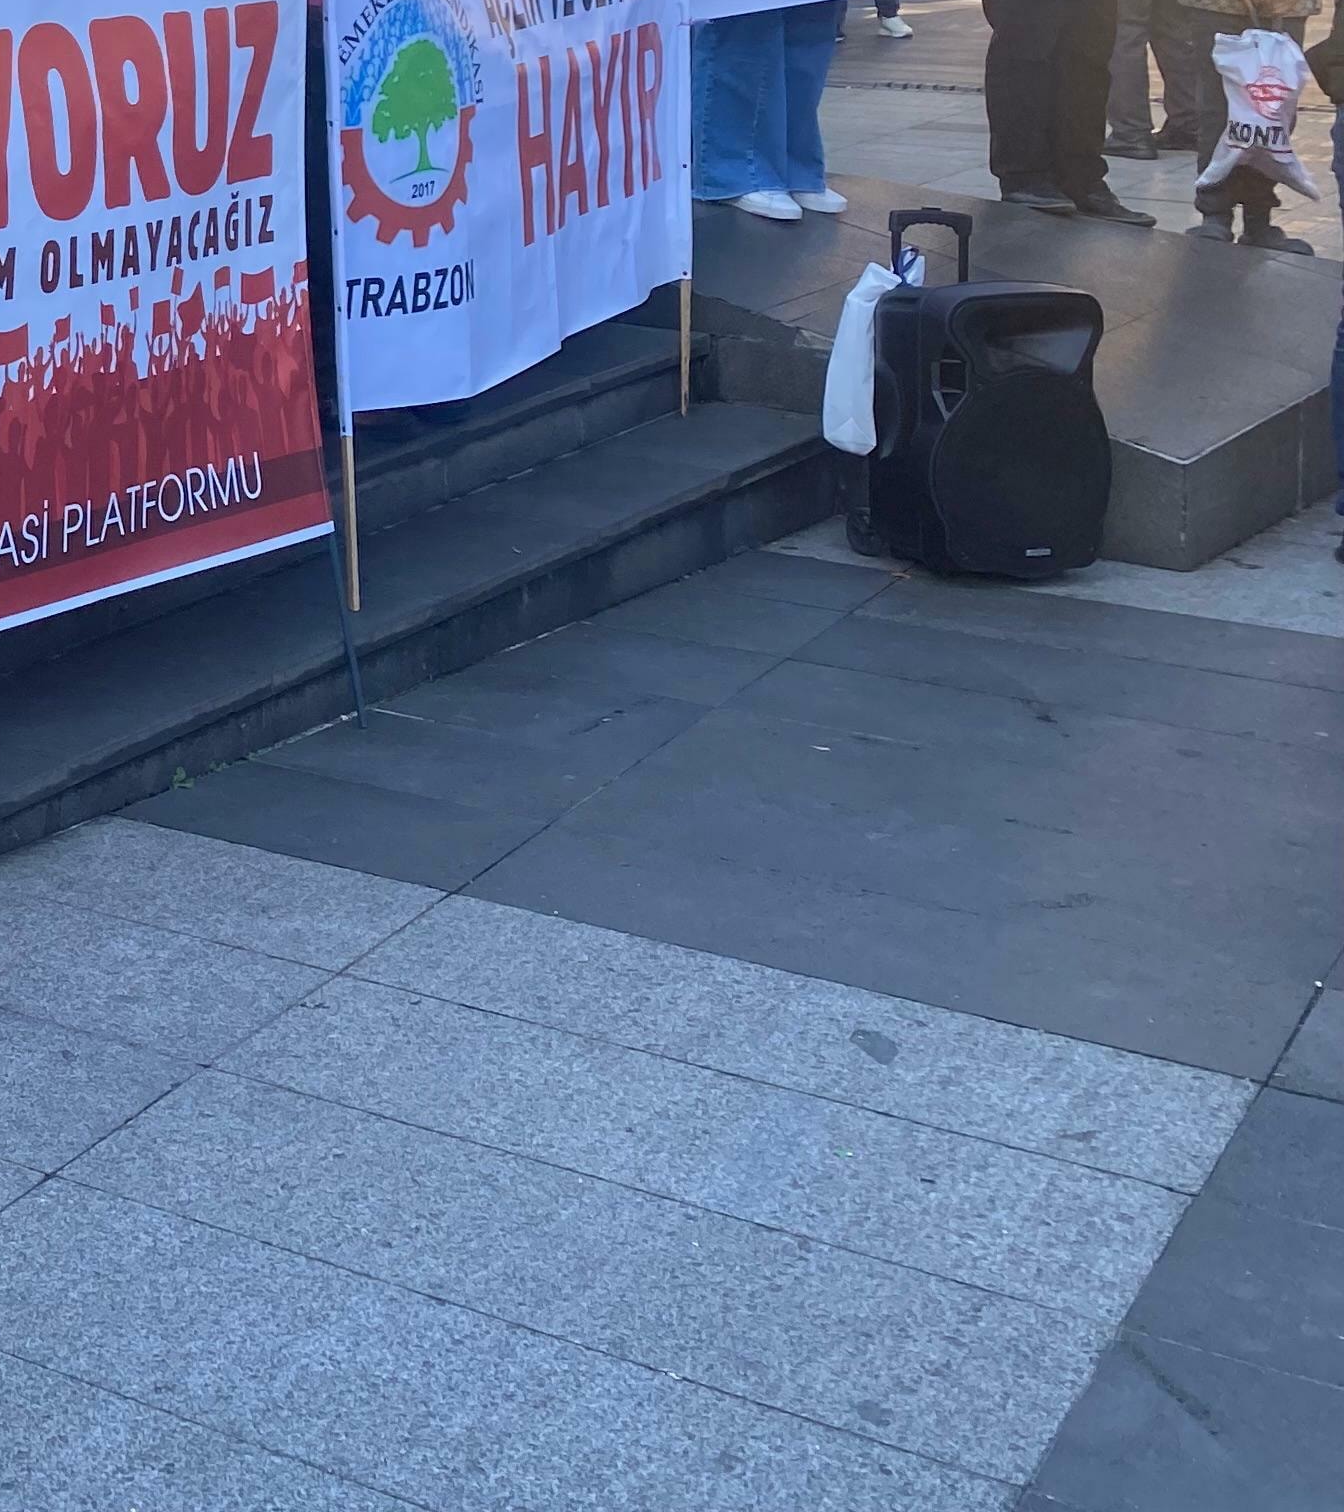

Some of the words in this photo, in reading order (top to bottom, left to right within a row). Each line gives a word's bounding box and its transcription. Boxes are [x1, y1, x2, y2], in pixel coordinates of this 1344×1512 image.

[516, 21, 664, 248] HAYIR
[411, 180, 436, 200] 2017
[39, 191, 275, 295] OLMAYACAĞIZ
[346, 258, 475, 320] TRABZON
[62, 449, 265, 549] PLATFORMU
